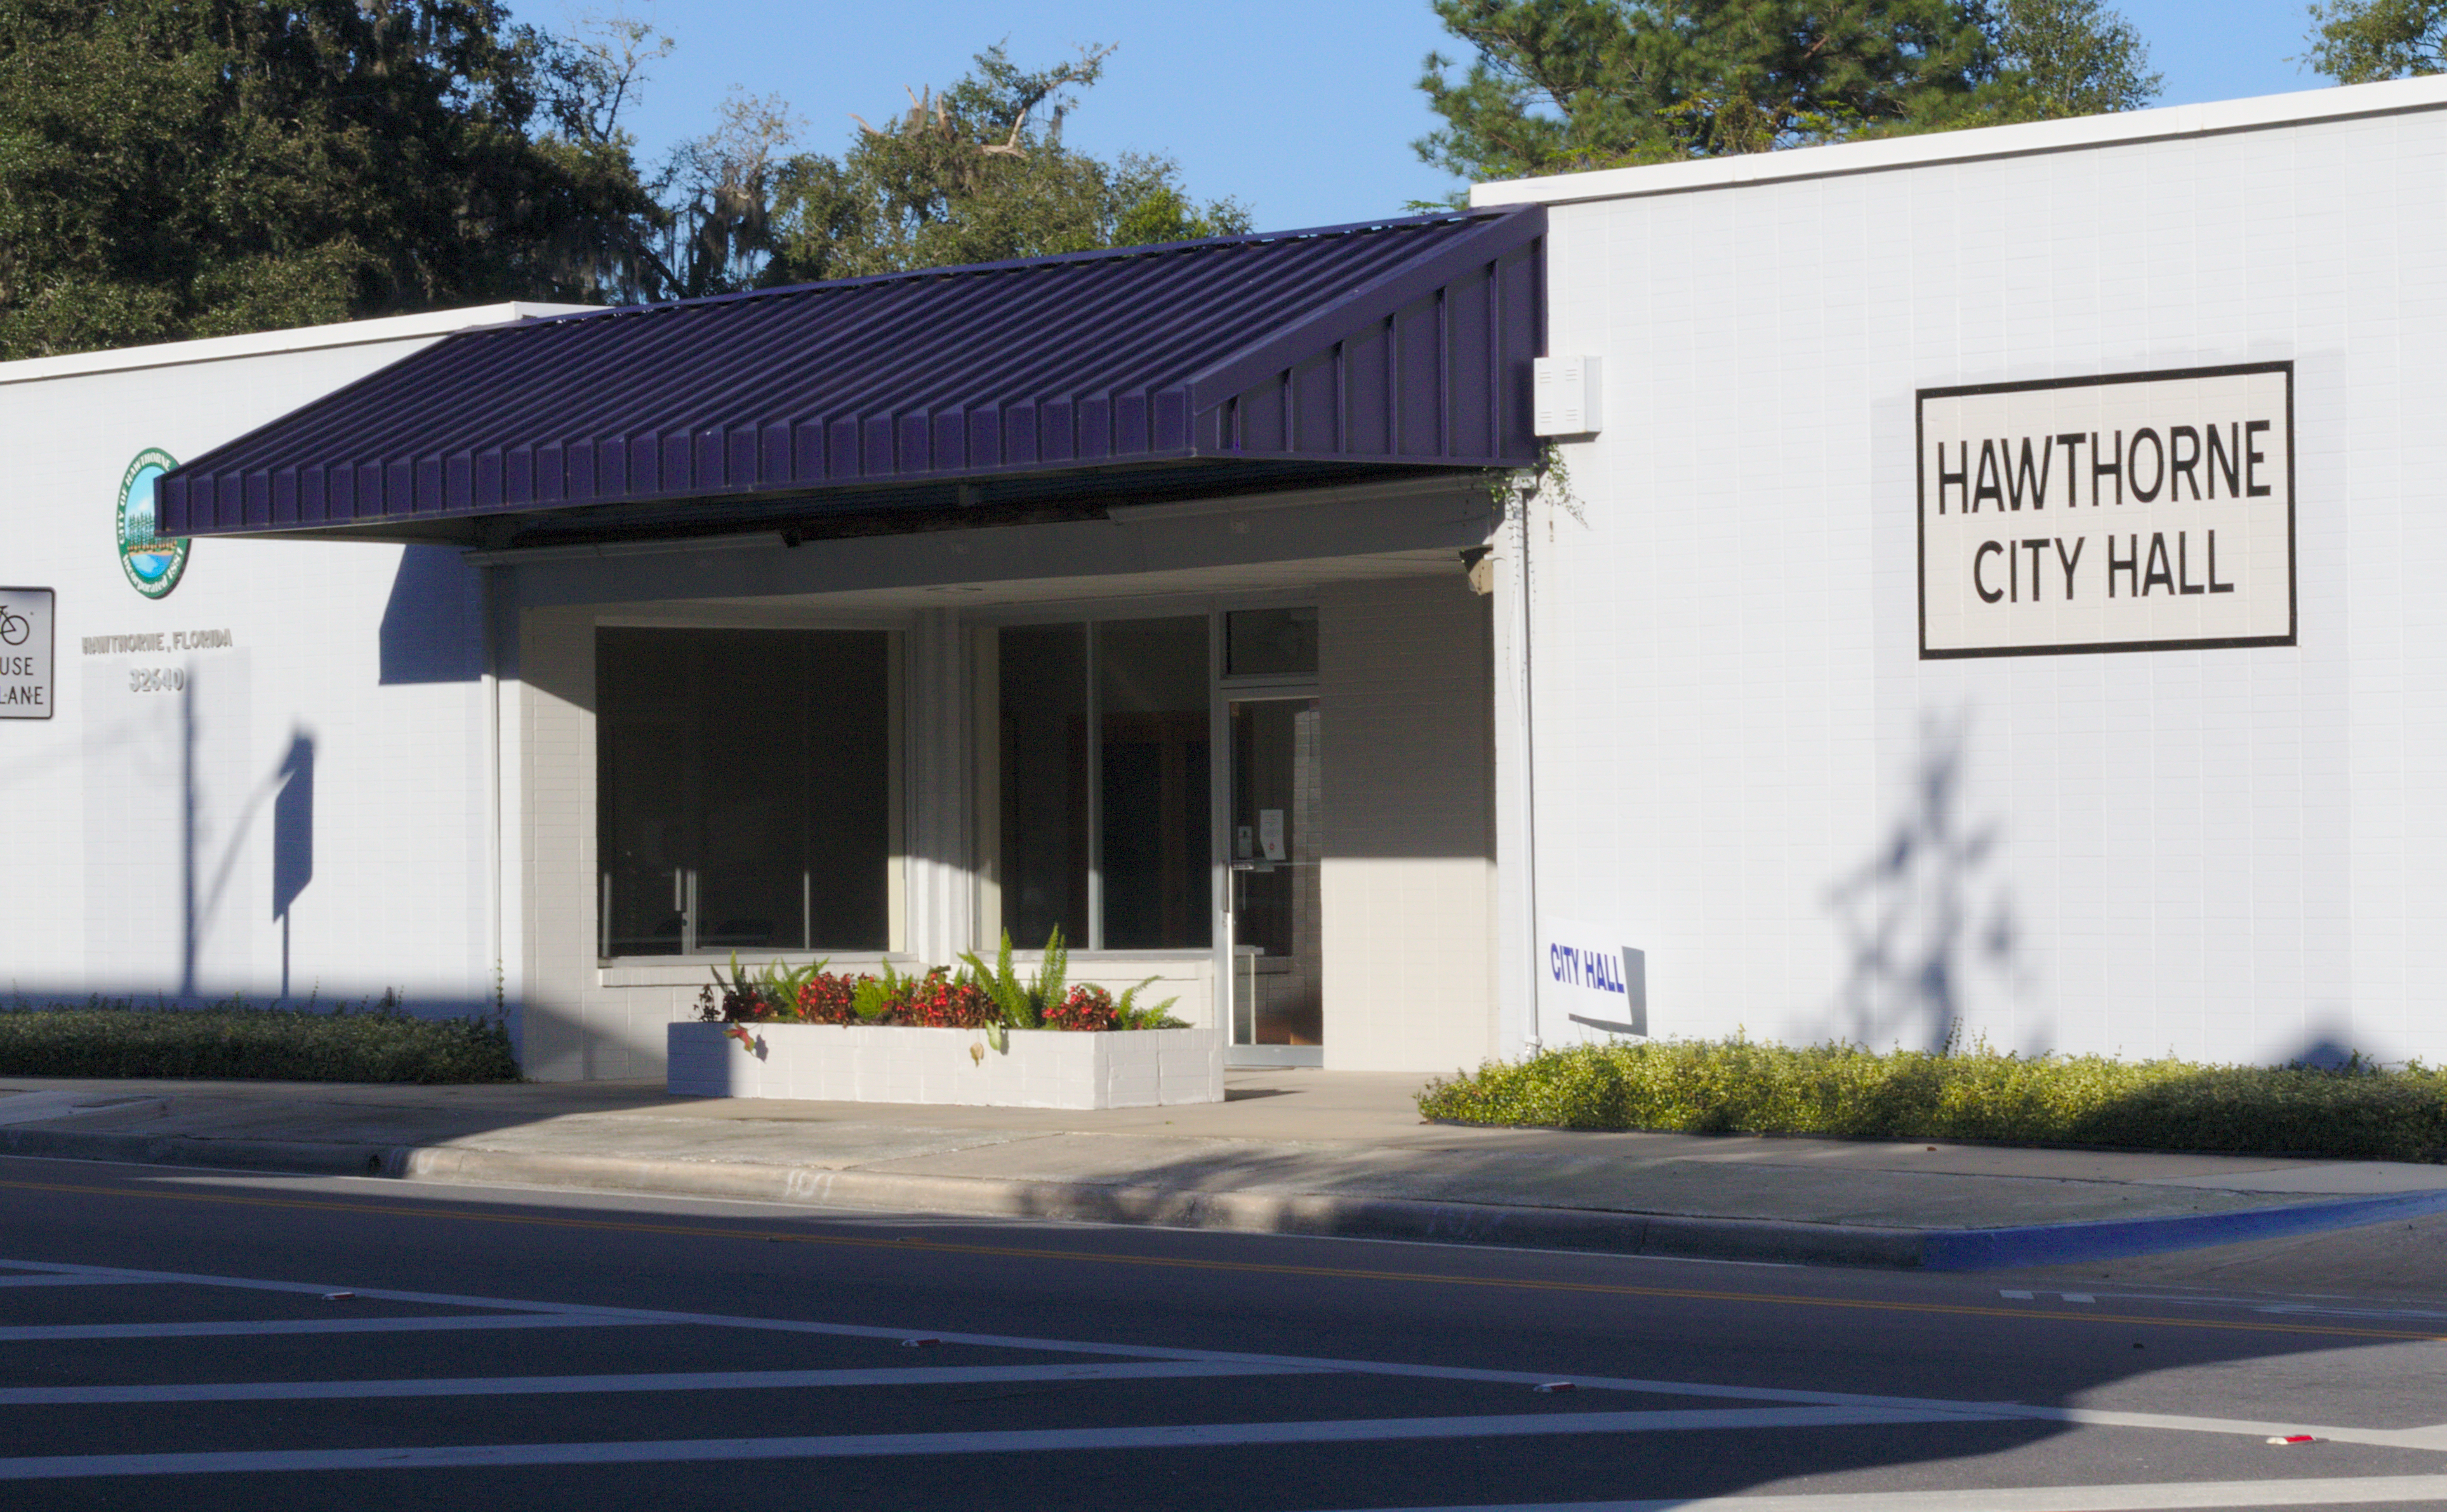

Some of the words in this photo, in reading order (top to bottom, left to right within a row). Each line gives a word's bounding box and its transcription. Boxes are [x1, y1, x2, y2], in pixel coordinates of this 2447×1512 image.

[1938, 420, 2271, 515] HAWTHORNE
[119, 486, 128, 506] OF
[1973, 536, 2086, 603] CITY
[2108, 529, 2234, 598] HALL
[172, 628, 232, 650] FLORIDA
[0, 656, 34, 675] USE
[129, 668, 184, 693] 32640
[1551, 943, 1579, 986] CITY
[1584, 950, 1625, 993] HALL
